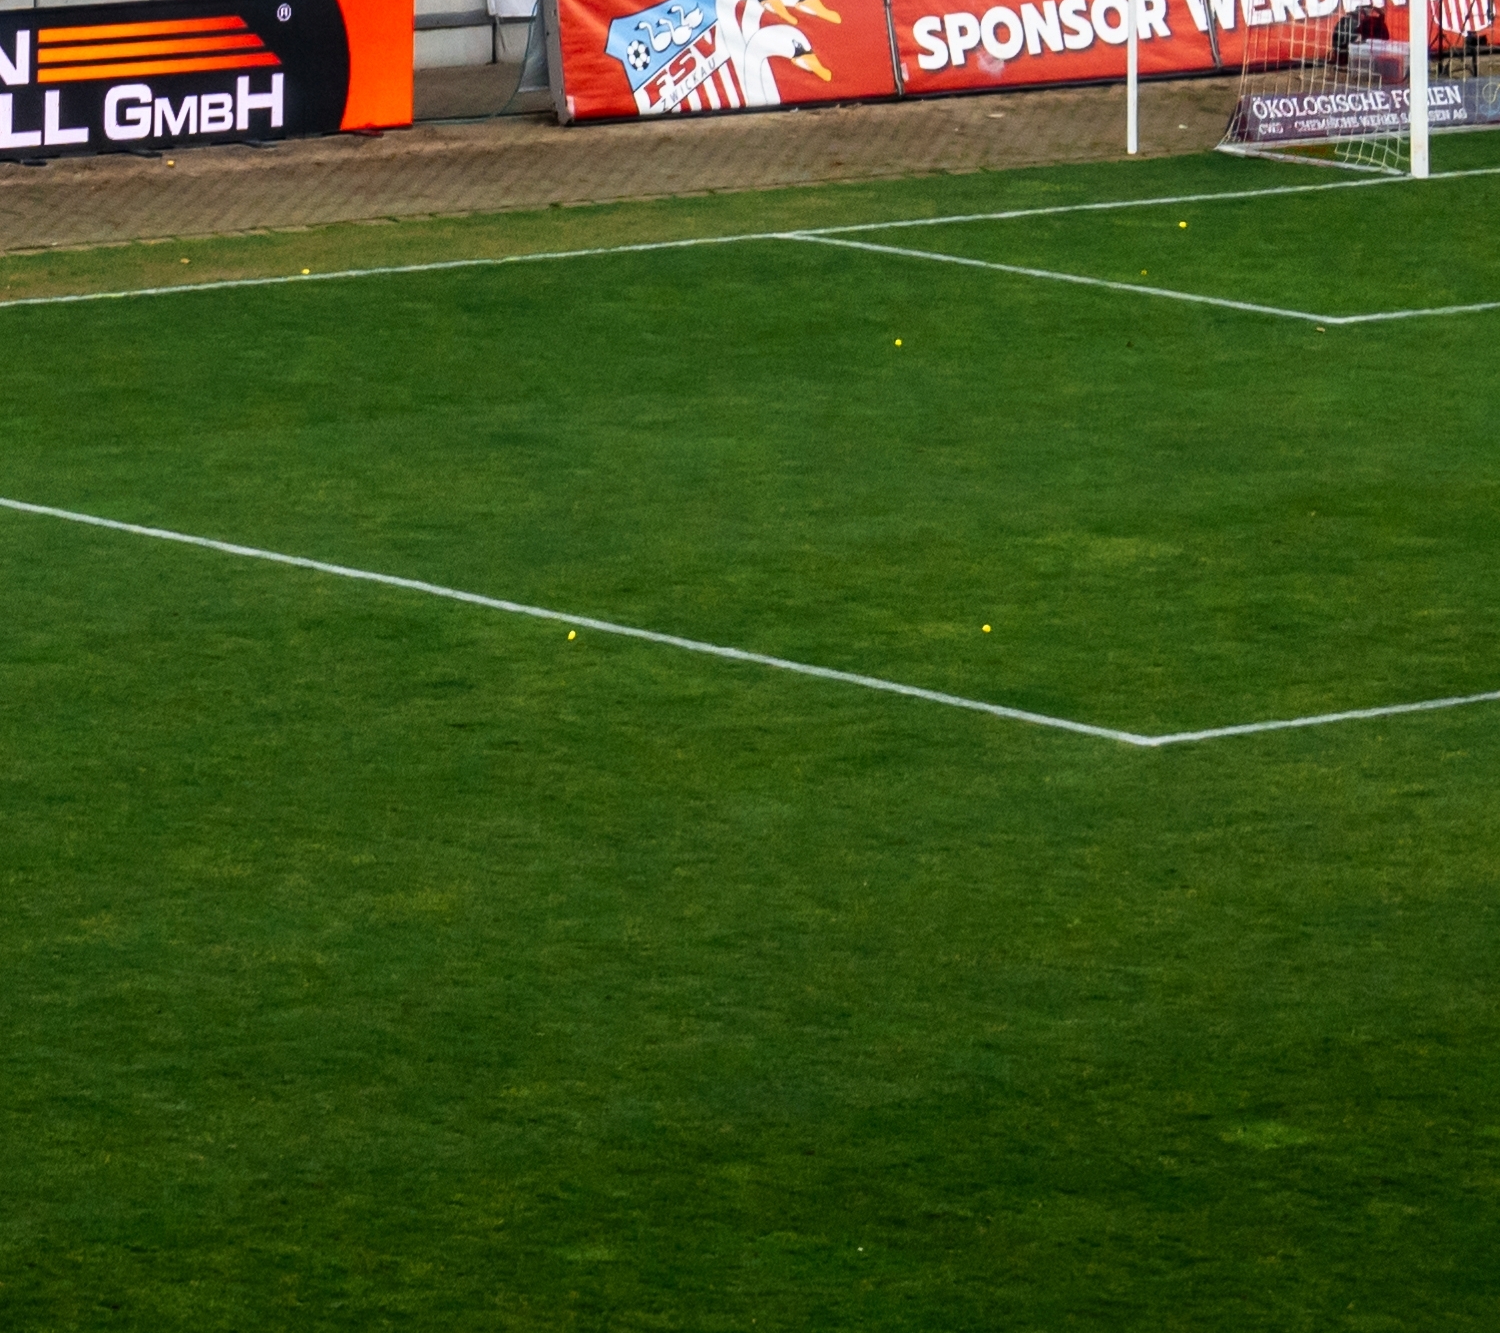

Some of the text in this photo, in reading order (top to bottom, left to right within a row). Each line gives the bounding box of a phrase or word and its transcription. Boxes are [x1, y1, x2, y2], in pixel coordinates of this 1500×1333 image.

[643, 25, 717, 109] FSV
[660, 56, 717, 112] ZWICKAU
[1252, 89, 1391, 120] ÖKOLOGISCHE
